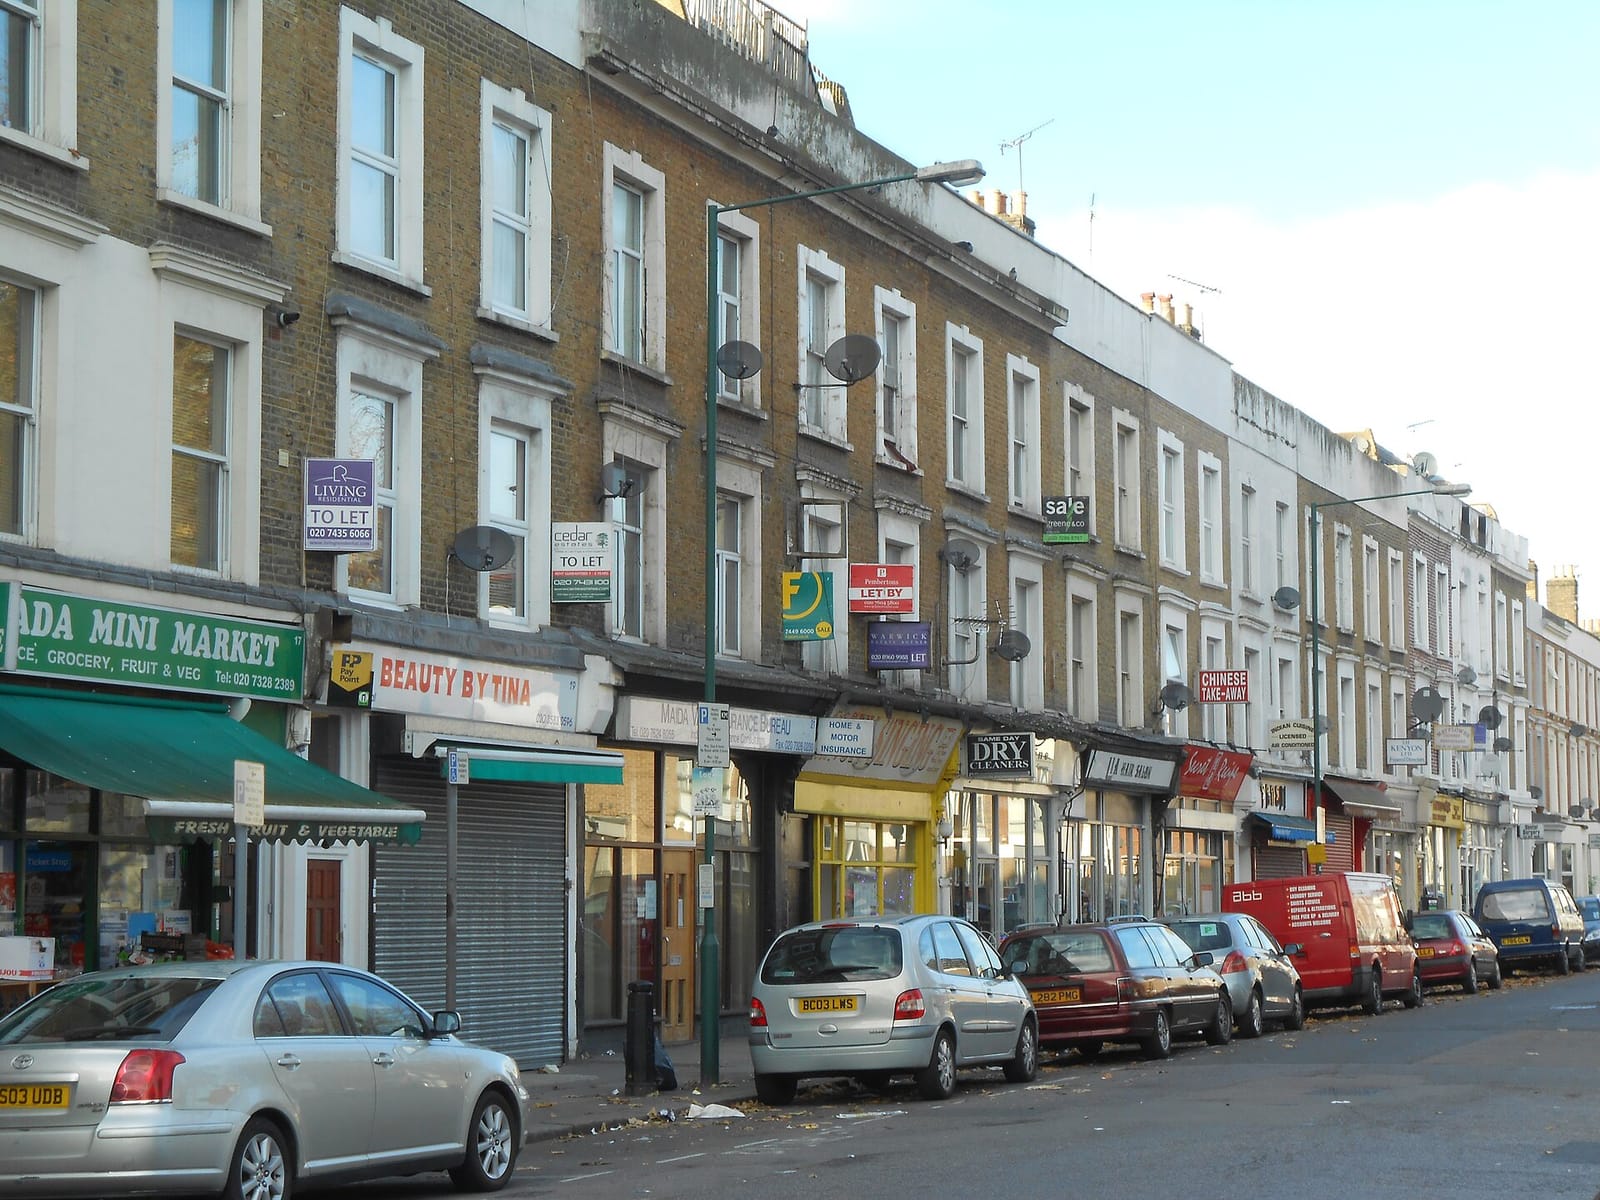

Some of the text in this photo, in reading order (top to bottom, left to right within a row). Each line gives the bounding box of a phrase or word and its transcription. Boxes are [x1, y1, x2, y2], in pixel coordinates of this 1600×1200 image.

[313, 485, 367, 497] LIVING
[1046, 497, 1085, 515] sale
[310, 509, 369, 525] TO LET
[309, 528, 370, 538] 020 7435 6066
[554, 524, 593, 542] cedar
[560, 556, 604, 567] TO LET
[861, 588, 903, 598] LET BY
[89, 608, 160, 651] MINI
[171, 621, 280, 668] MARKET
[294, 635, 302, 646] 17
[871, 632, 927, 640] WARWICK
[911, 653, 927, 662] LET
[47, 649, 114, 673] GROCERY,
[121, 658, 158, 675] FRUIT
[162, 664, 172, 677] &
[177, 665, 201, 681] VEG
[340, 668, 354, 677] Pay
[1202, 671, 1247, 686] CHINESE
[215, 670, 295, 691] Tel: 020 7328 2389
[340, 675, 360, 683] Point
[380, 657, 531, 706] BEAUTY BY TINA
[1201, 686, 1247, 702] TAKE-AWAY
[661, 703, 689, 725] MAIDA
[730, 713, 759, 732] RANCE
[760, 713, 792, 736] BUREAU
[829, 721, 852, 729] HOME
[830, 733, 859, 742] MOTOR
[820, 745, 867, 755] INSURANCE
[971, 741, 1027, 761] DRY
[969, 760, 1029, 770] CLEANERS
[174, 821, 398, 838] FRESH RUIT & VEGETABLE
[1232, 890, 1262, 903] abb
[0, 968, 17, 977] JOU
[1058, 990, 1078, 1001] PMG
[803, 998, 854, 1010] BC03 LWS
[32, 1088, 63, 1105] UDB
